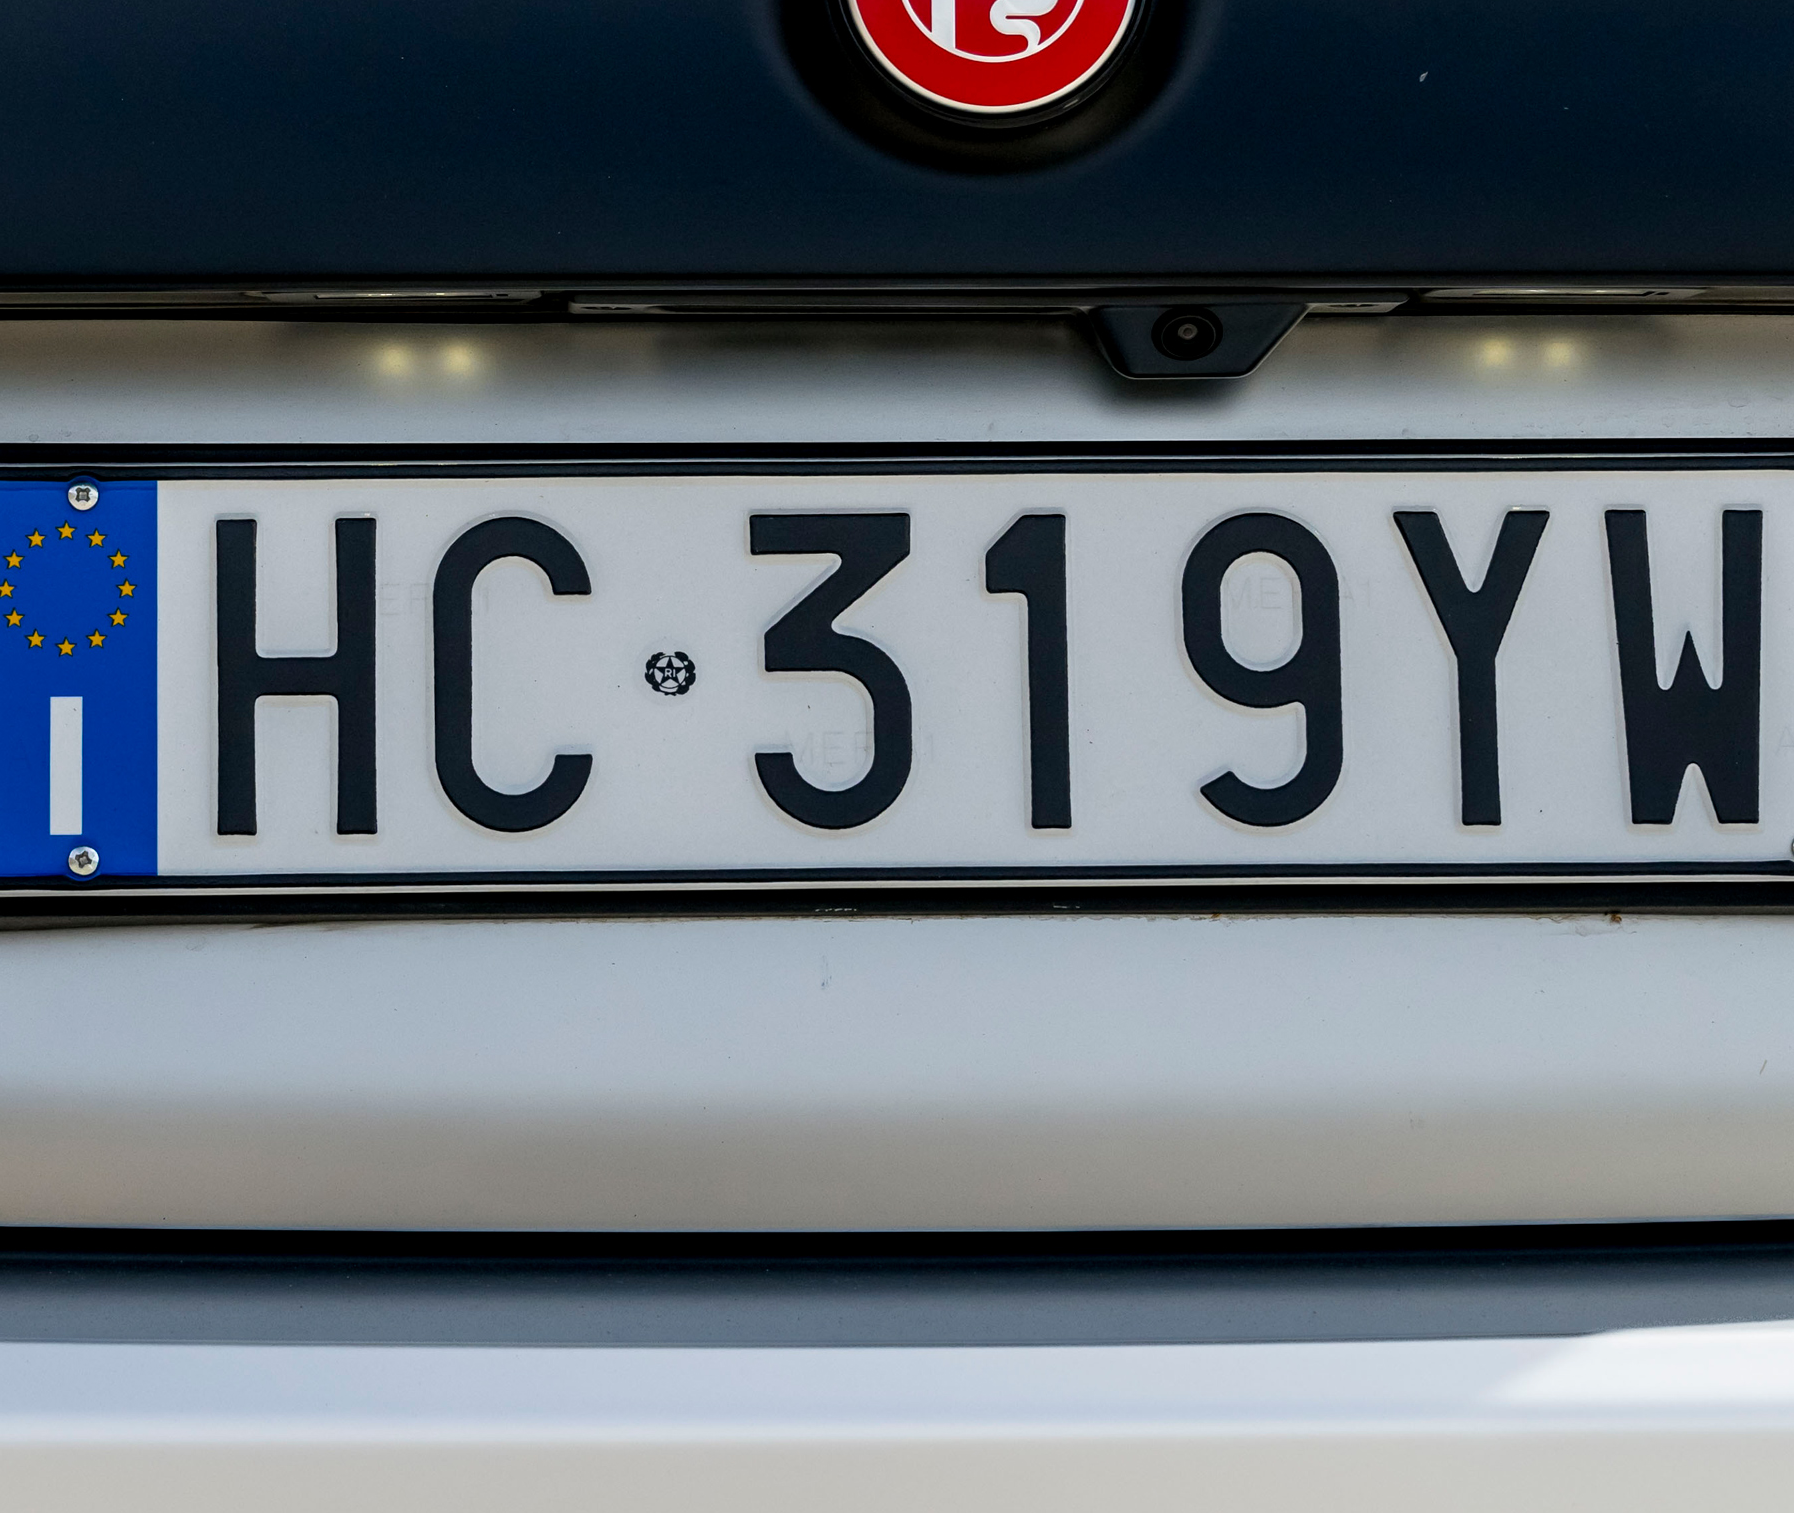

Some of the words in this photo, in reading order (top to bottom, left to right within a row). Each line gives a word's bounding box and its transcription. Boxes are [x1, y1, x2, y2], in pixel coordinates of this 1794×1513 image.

[214, 515, 595, 837] HC
[747, 508, 1765, 831] 319YW
[664, 668, 676, 678] RI
[49, 696, 84, 836] I
